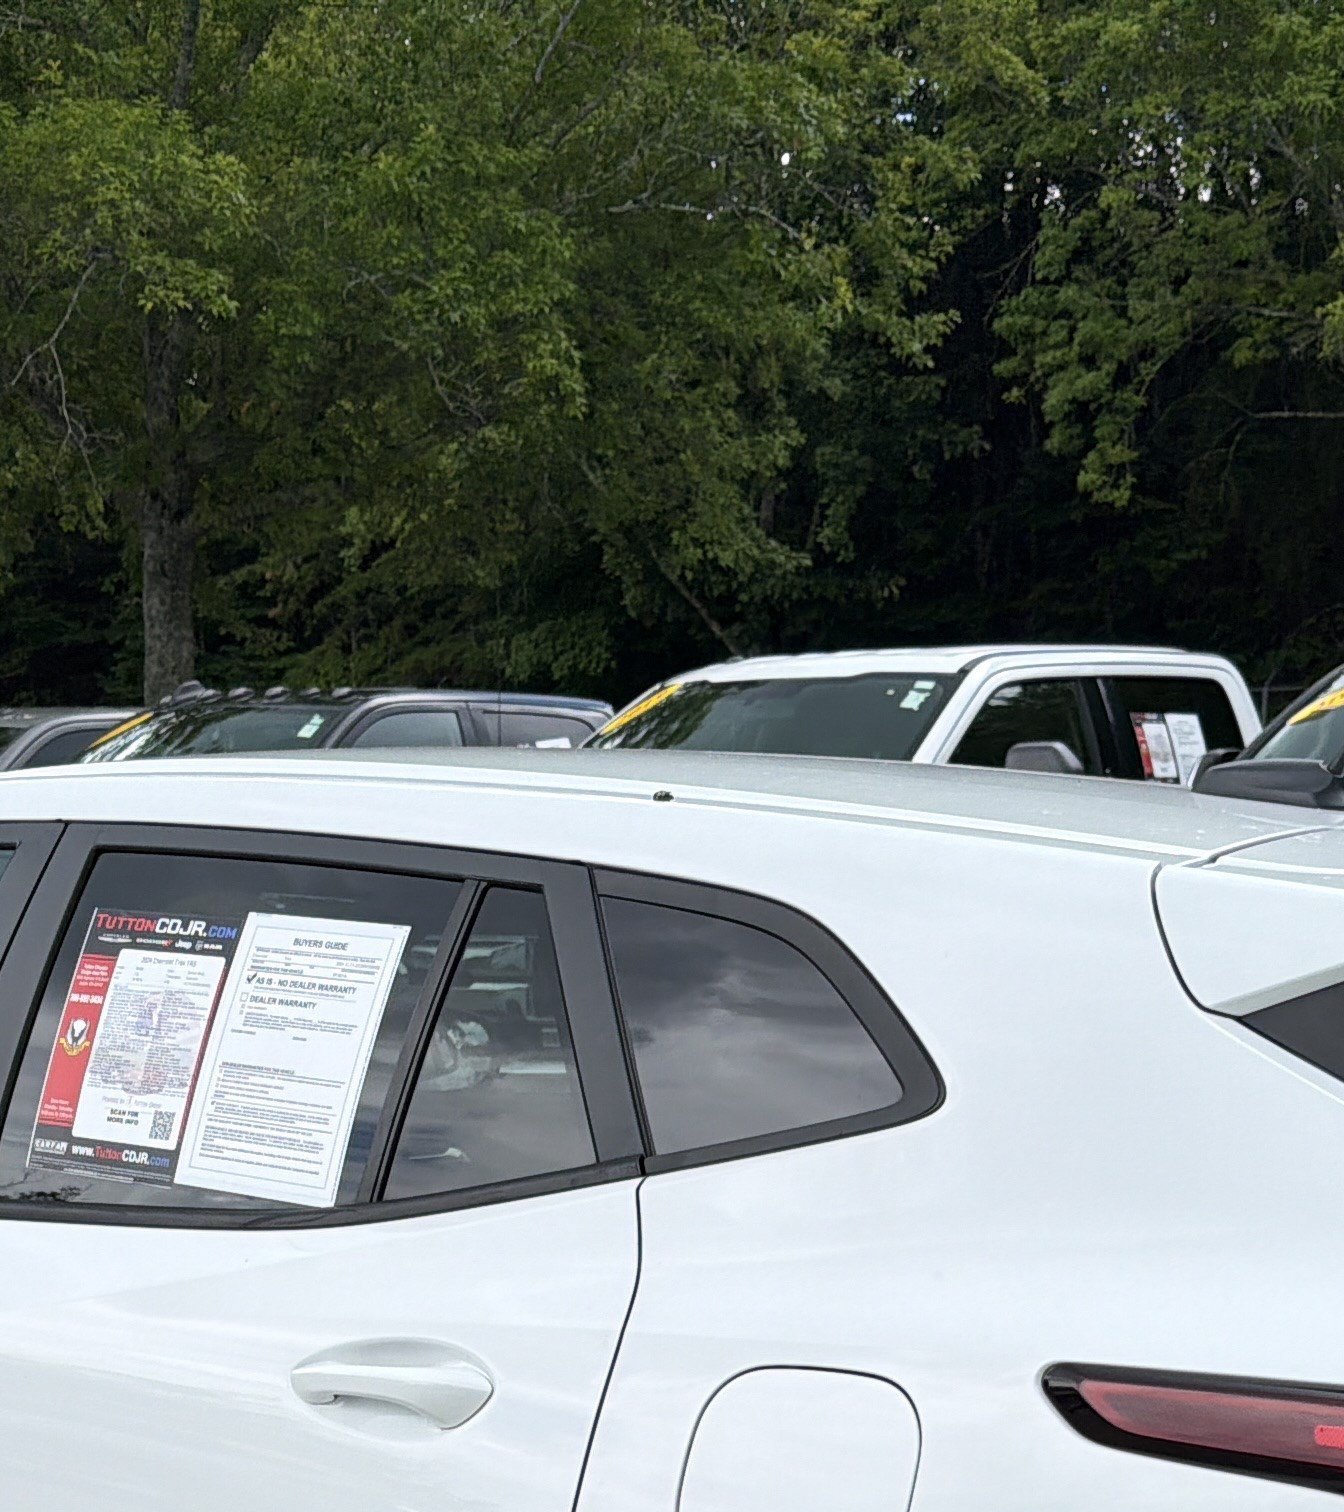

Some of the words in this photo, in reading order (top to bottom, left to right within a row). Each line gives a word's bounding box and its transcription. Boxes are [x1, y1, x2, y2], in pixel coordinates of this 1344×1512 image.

[97, 914, 237, 939] TUTTONCDJR.COM
[293, 938, 322, 949] BUYERS
[325, 941, 348, 950] GUIDE
[256, 977, 265, 985] AS
[290, 981, 316, 990] DEALER
[318, 984, 357, 995] WARRANTY
[250, 995, 277, 1004] DEALER
[278, 999, 317, 1009] WARRANTY
[110, 1108, 126, 1116] SCAN
[72, 1145, 170, 1167] www.TuttonCDJR.com
